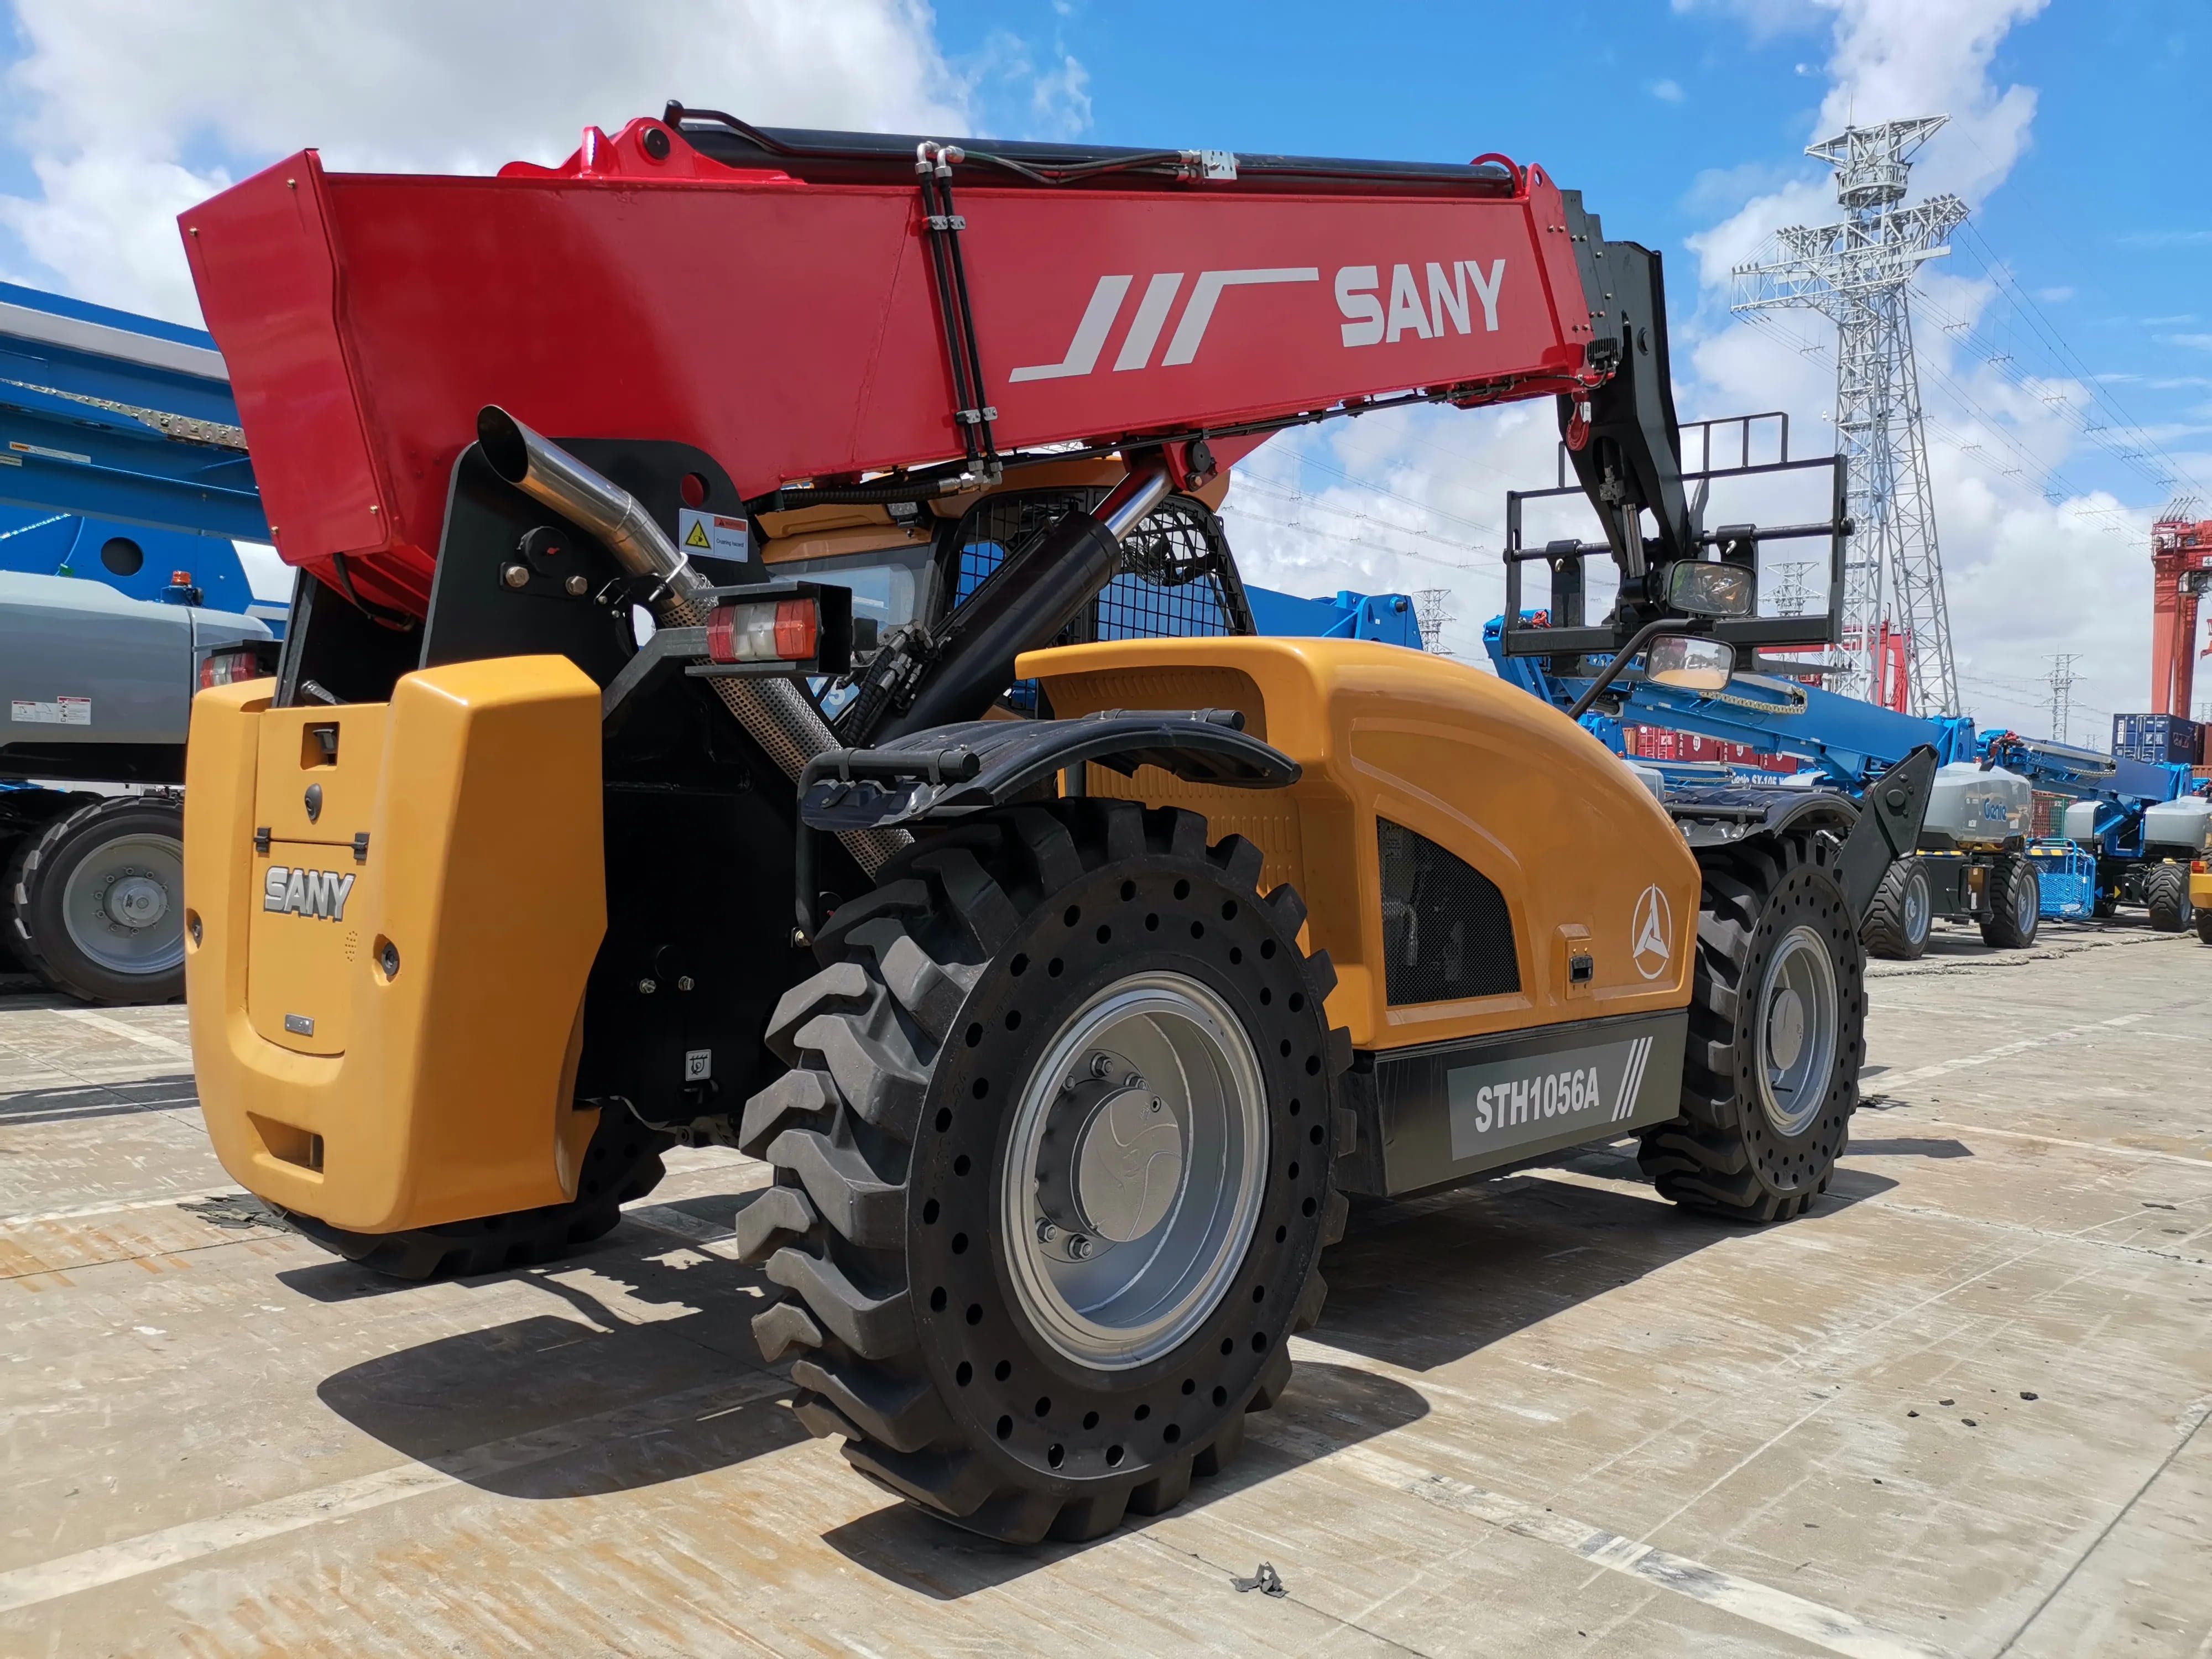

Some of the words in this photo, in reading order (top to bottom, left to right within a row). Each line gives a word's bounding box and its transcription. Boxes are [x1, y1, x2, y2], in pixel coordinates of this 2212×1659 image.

[1334, 259, 1506, 347] SANY
[1984, 797, 2007, 822] Genie
[264, 865, 356, 923] SANY
[1475, 1067, 1599, 1133] STH1056A
